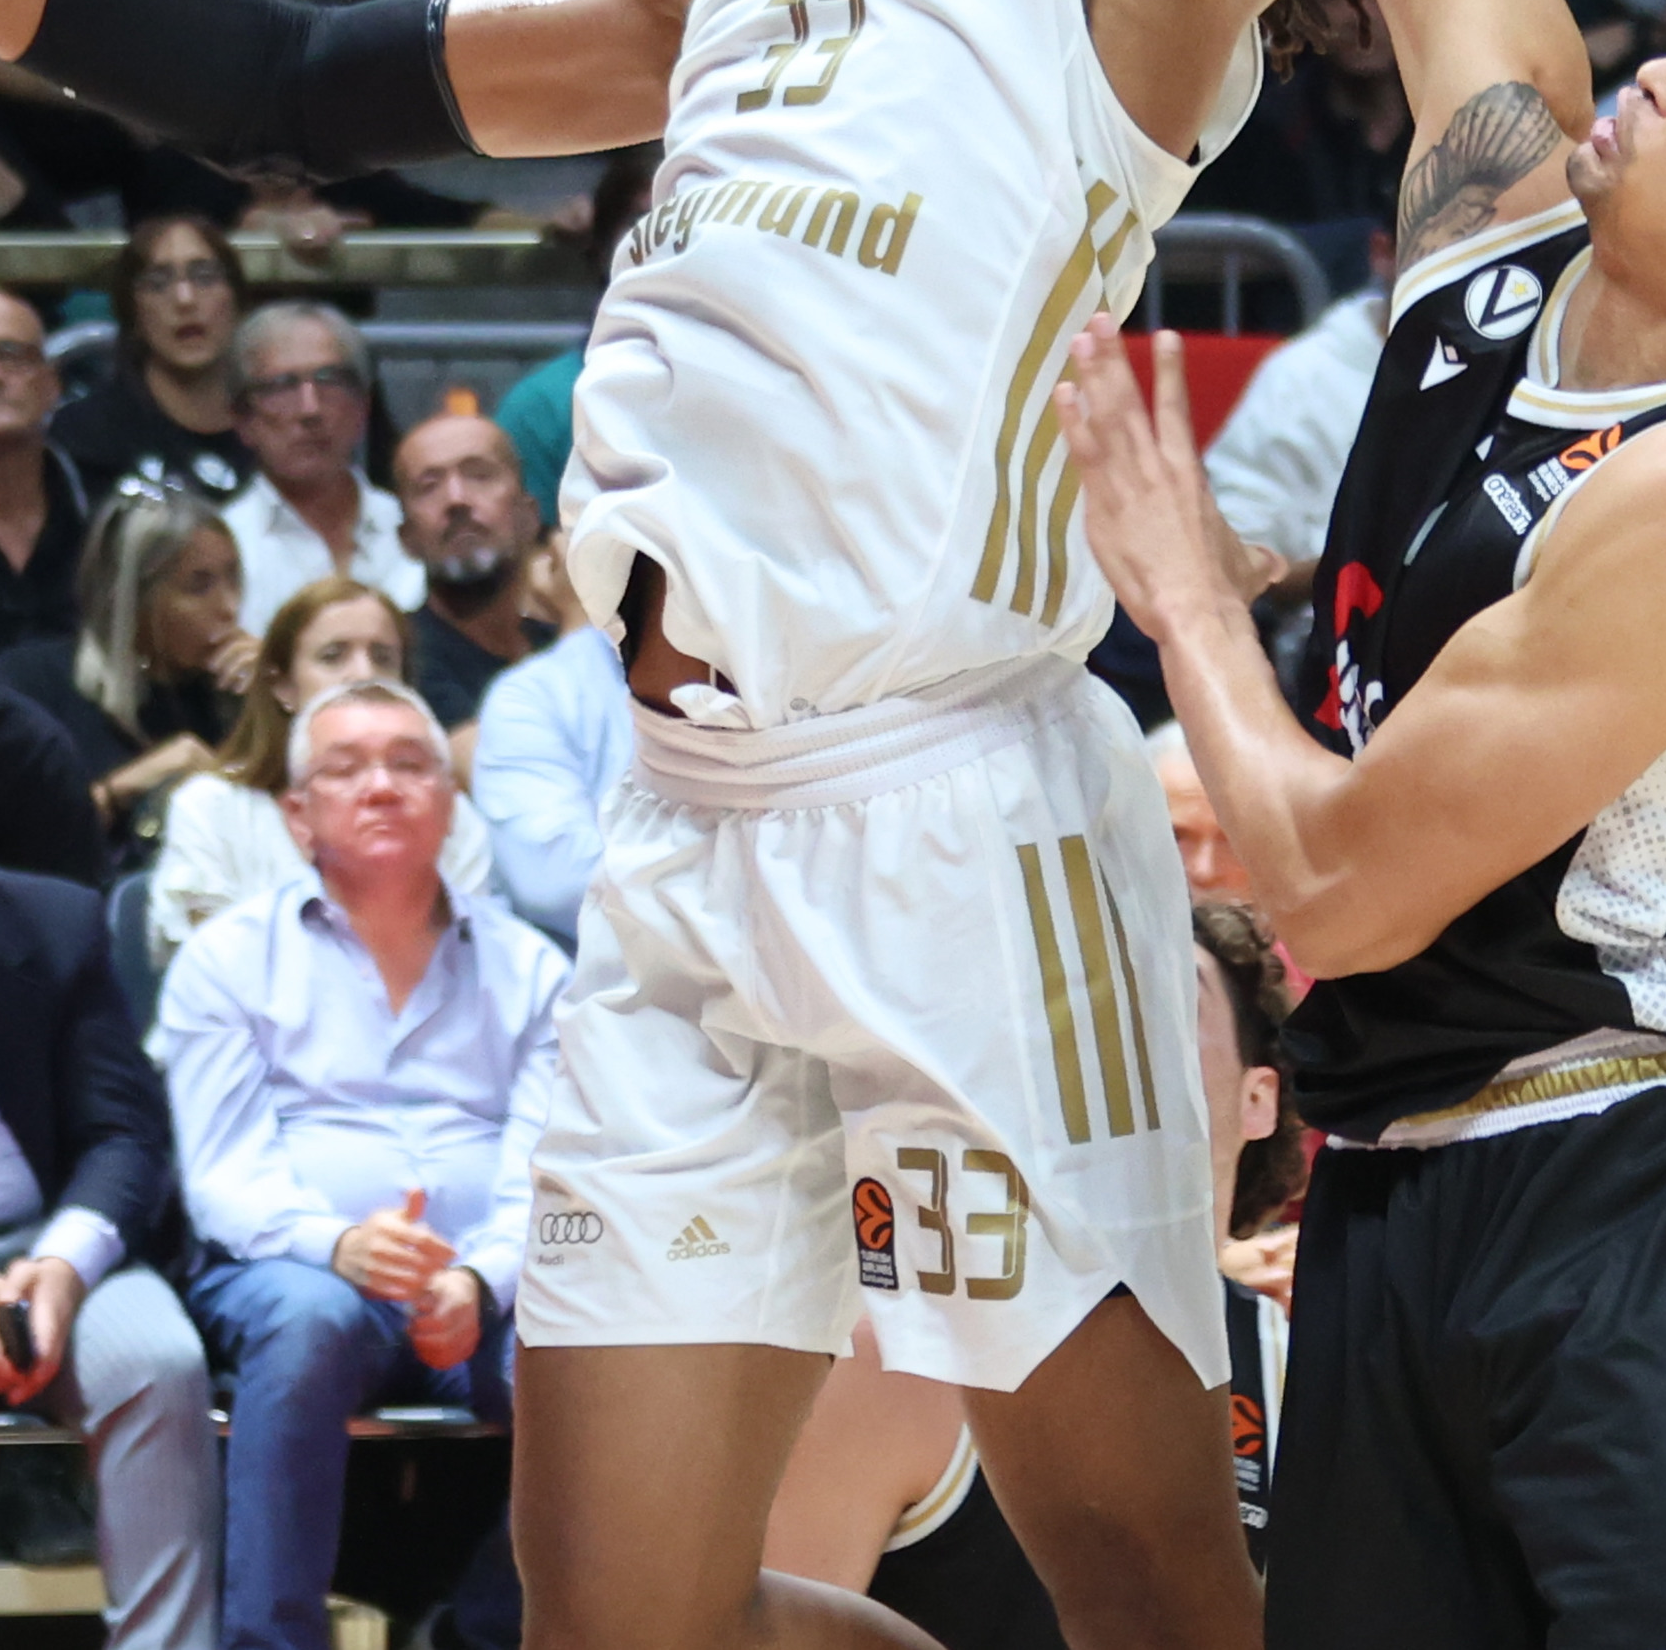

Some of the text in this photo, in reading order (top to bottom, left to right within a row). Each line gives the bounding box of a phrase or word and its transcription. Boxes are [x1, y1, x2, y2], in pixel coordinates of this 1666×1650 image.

[629, 180, 924, 277] siegmund
[666, 1241, 732, 1262] adidas
[896, 1147, 1031, 1301] 33
